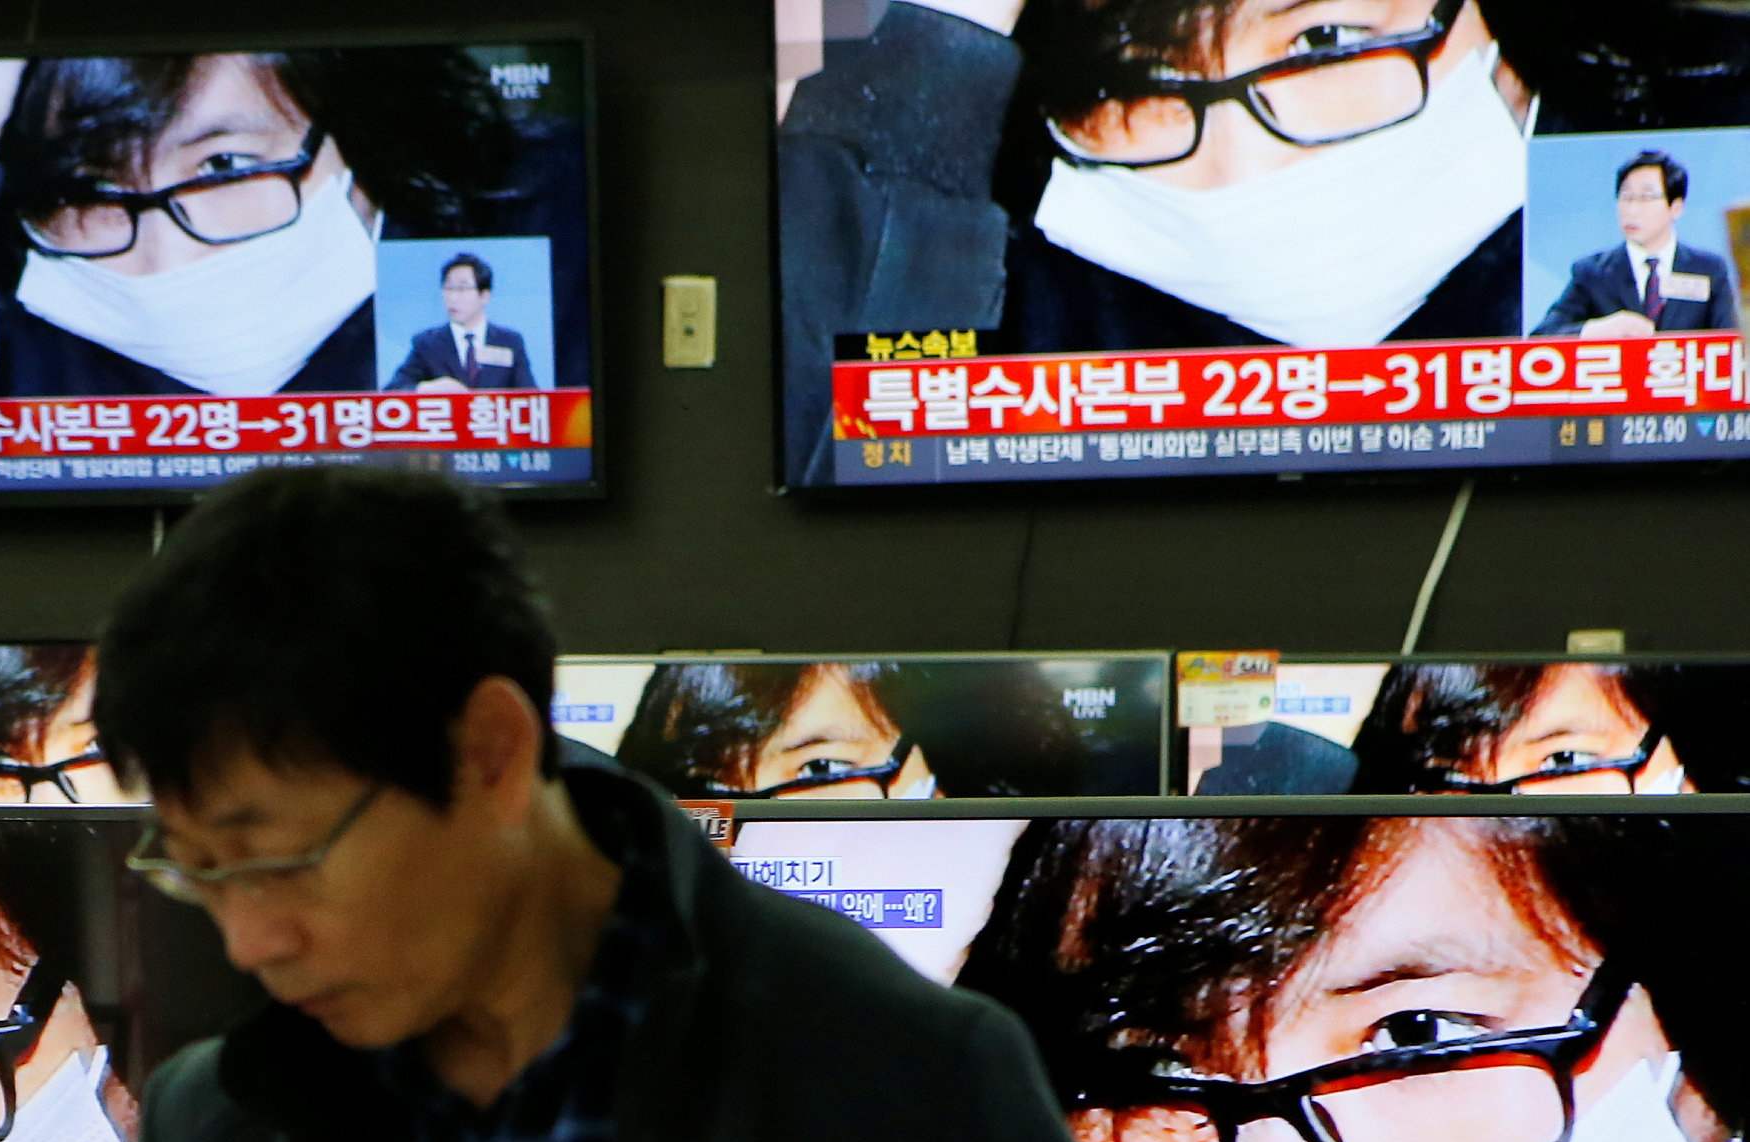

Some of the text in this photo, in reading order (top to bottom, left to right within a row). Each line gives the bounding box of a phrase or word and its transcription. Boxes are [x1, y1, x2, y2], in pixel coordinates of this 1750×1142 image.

[866, 329, 978, 362] 뉴스속보
[862, 359, 1185, 431] 특별수사본부
[1644, 339, 1750, 406] 확대
[467, 394, 551, 445] 확대
[945, 439, 989, 466] 남북
[995, 435, 1083, 464] 학생단체
[1215, 427, 1301, 457] 실무접촉
[1308, 425, 1352, 454] 이번
[1360, 424, 1383, 453] 달
[1388, 422, 1434, 452] 하순
[1622, 414, 1687, 444] 252.90
